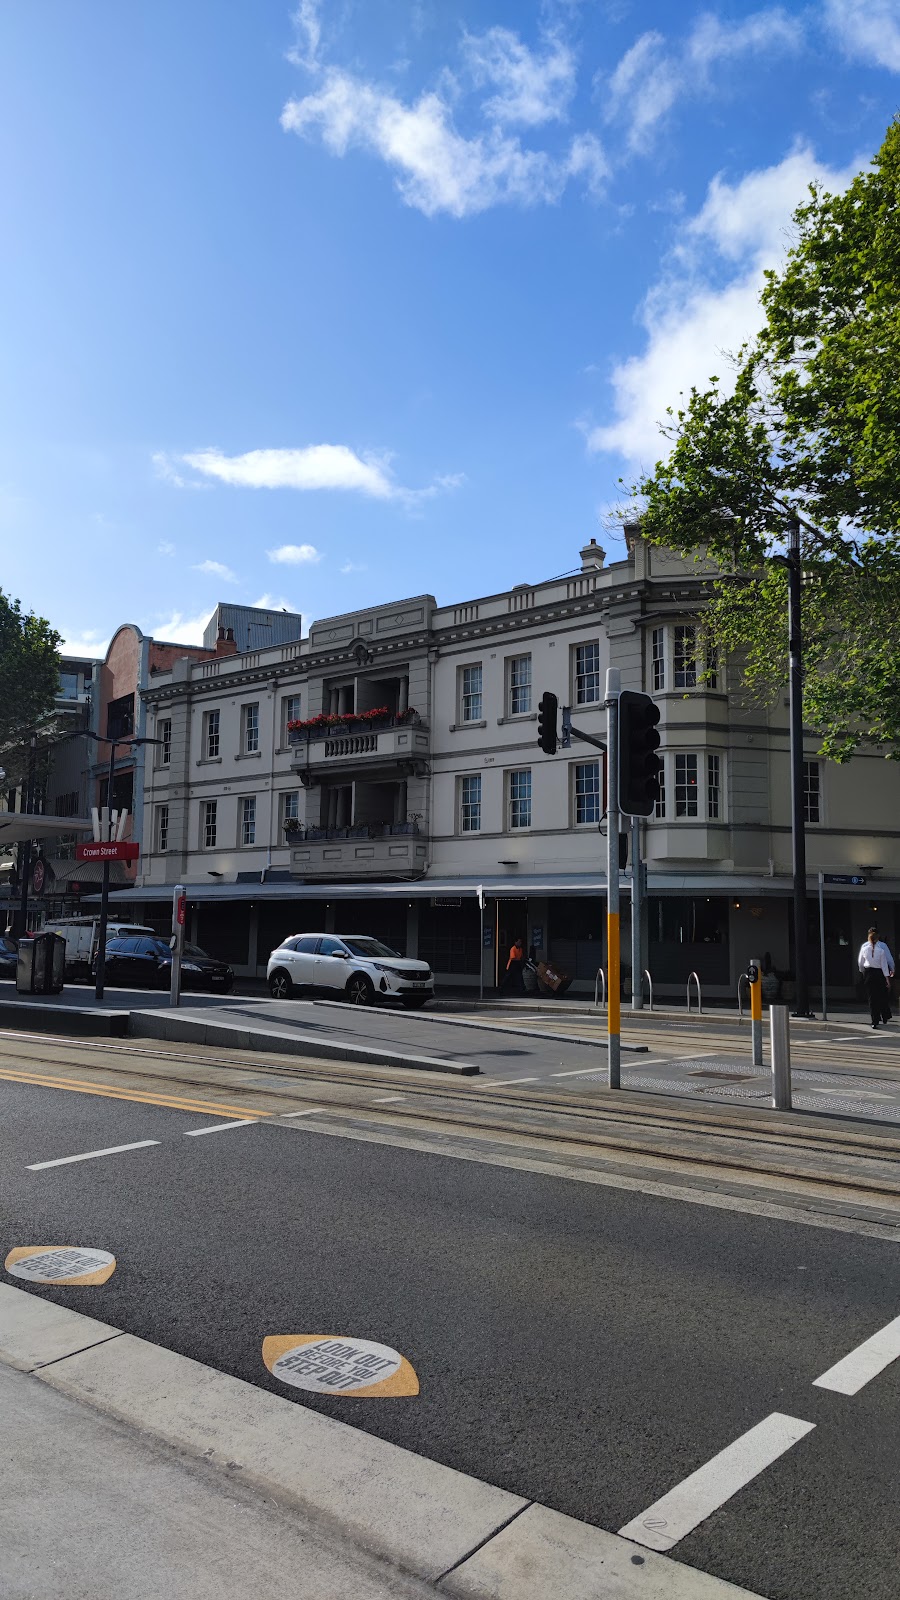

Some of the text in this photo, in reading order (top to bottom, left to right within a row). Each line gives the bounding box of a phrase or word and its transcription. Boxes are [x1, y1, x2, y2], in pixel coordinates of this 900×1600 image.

[83, 847, 117, 857] Crown Street
[297, 1348, 378, 1380] BEFORE YOU
[313, 1340, 398, 1371] LOOK OUT
[276, 1355, 362, 1389] STEP OUT
